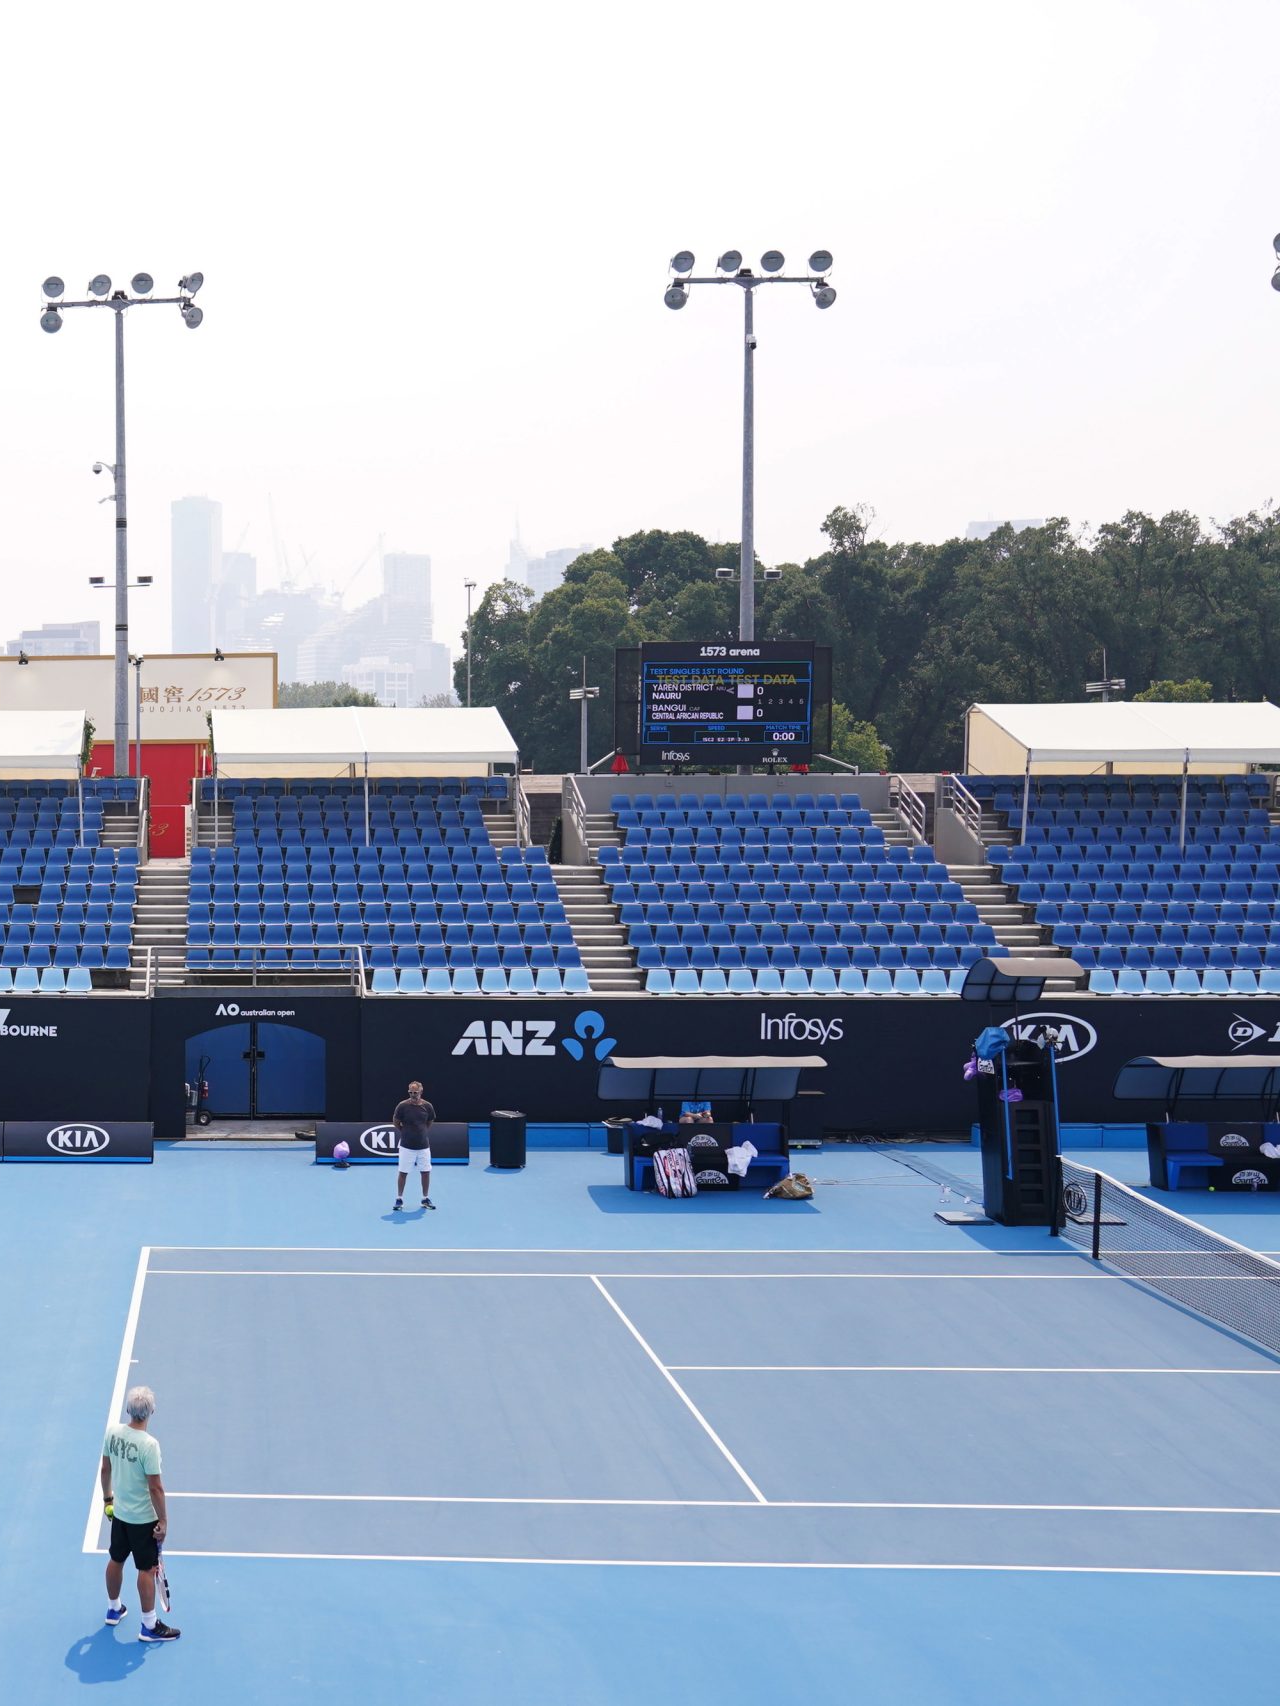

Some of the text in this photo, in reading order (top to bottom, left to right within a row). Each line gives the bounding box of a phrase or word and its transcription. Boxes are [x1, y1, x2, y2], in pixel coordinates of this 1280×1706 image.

[700, 646, 760, 657] 1573 arena
[718, 667, 745, 675] ROUND
[657, 674, 797, 686] TEST DATA TEST DATA
[652, 683, 678, 692] YAREN
[679, 683, 714, 692] DISTRICT
[756, 686, 764, 696] 0
[652, 692, 682, 700] NAURU
[138, 705, 202, 713] GUOJIAO
[652, 704, 687, 712] BANGUI
[756, 708, 764, 718] 0
[651, 712, 724, 720] CENTRAL AFRICAN REPUBLIC
[772, 732, 795, 741] 0:00
[661, 750, 690, 762] Infosys
[215, 1003, 240, 1016] AO
[760, 1012, 844, 1045] Infosys
[451, 1020, 556, 1056] ANZ
[1011, 1024, 1080, 1052] KA
[57, 1130, 99, 1149] KIA
[370, 1131, 401, 1149] KI
[109, 1434, 138, 1463] NYC
